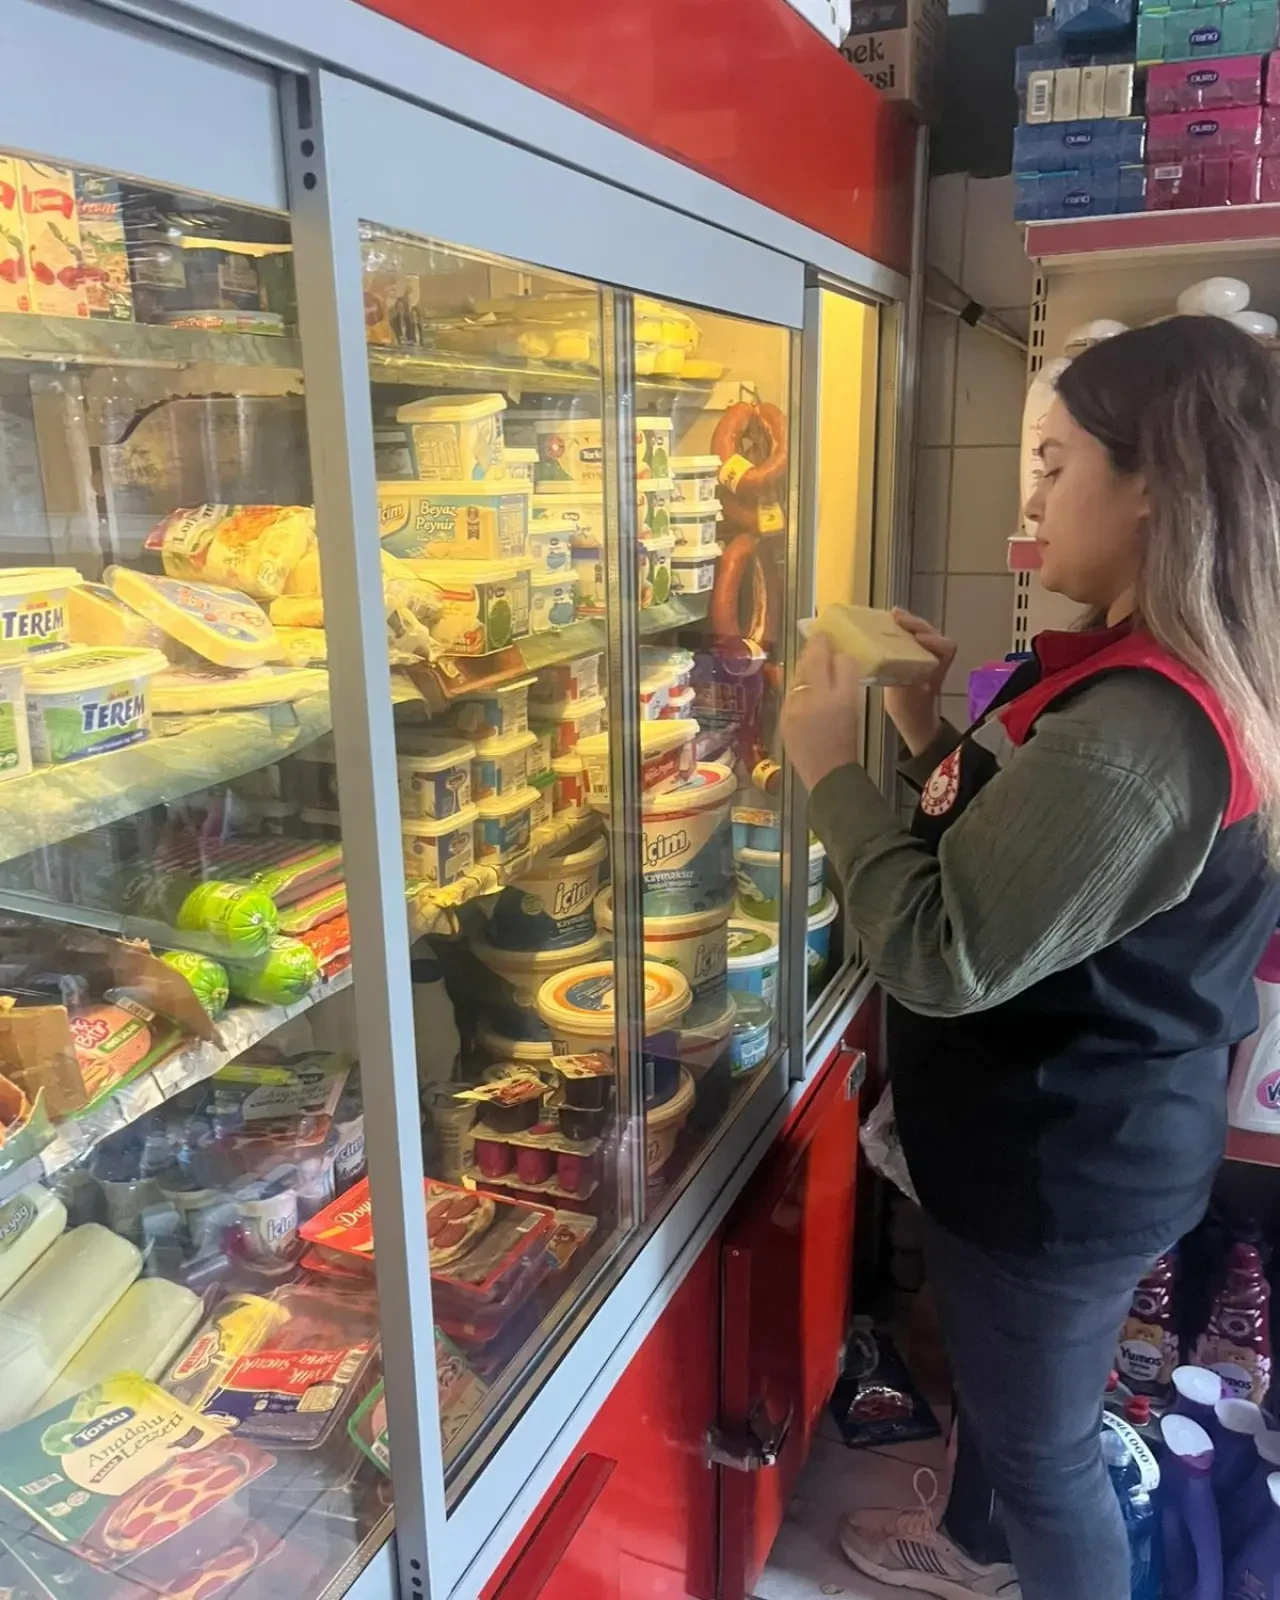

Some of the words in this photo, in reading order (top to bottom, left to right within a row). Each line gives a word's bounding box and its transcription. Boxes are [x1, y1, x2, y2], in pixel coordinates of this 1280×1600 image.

[581, 450, 603, 460] Tork
[415, 516, 455, 534] Peynir
[420, 500, 459, 518] Beyaz
[2, 606, 63, 638] TEREM
[82, 692, 145, 731] TEREM
[76, 1409, 130, 1442] Torku
[88, 1414, 165, 1468] Anadolu
[120, 1410, 184, 1460] Lezzeti
